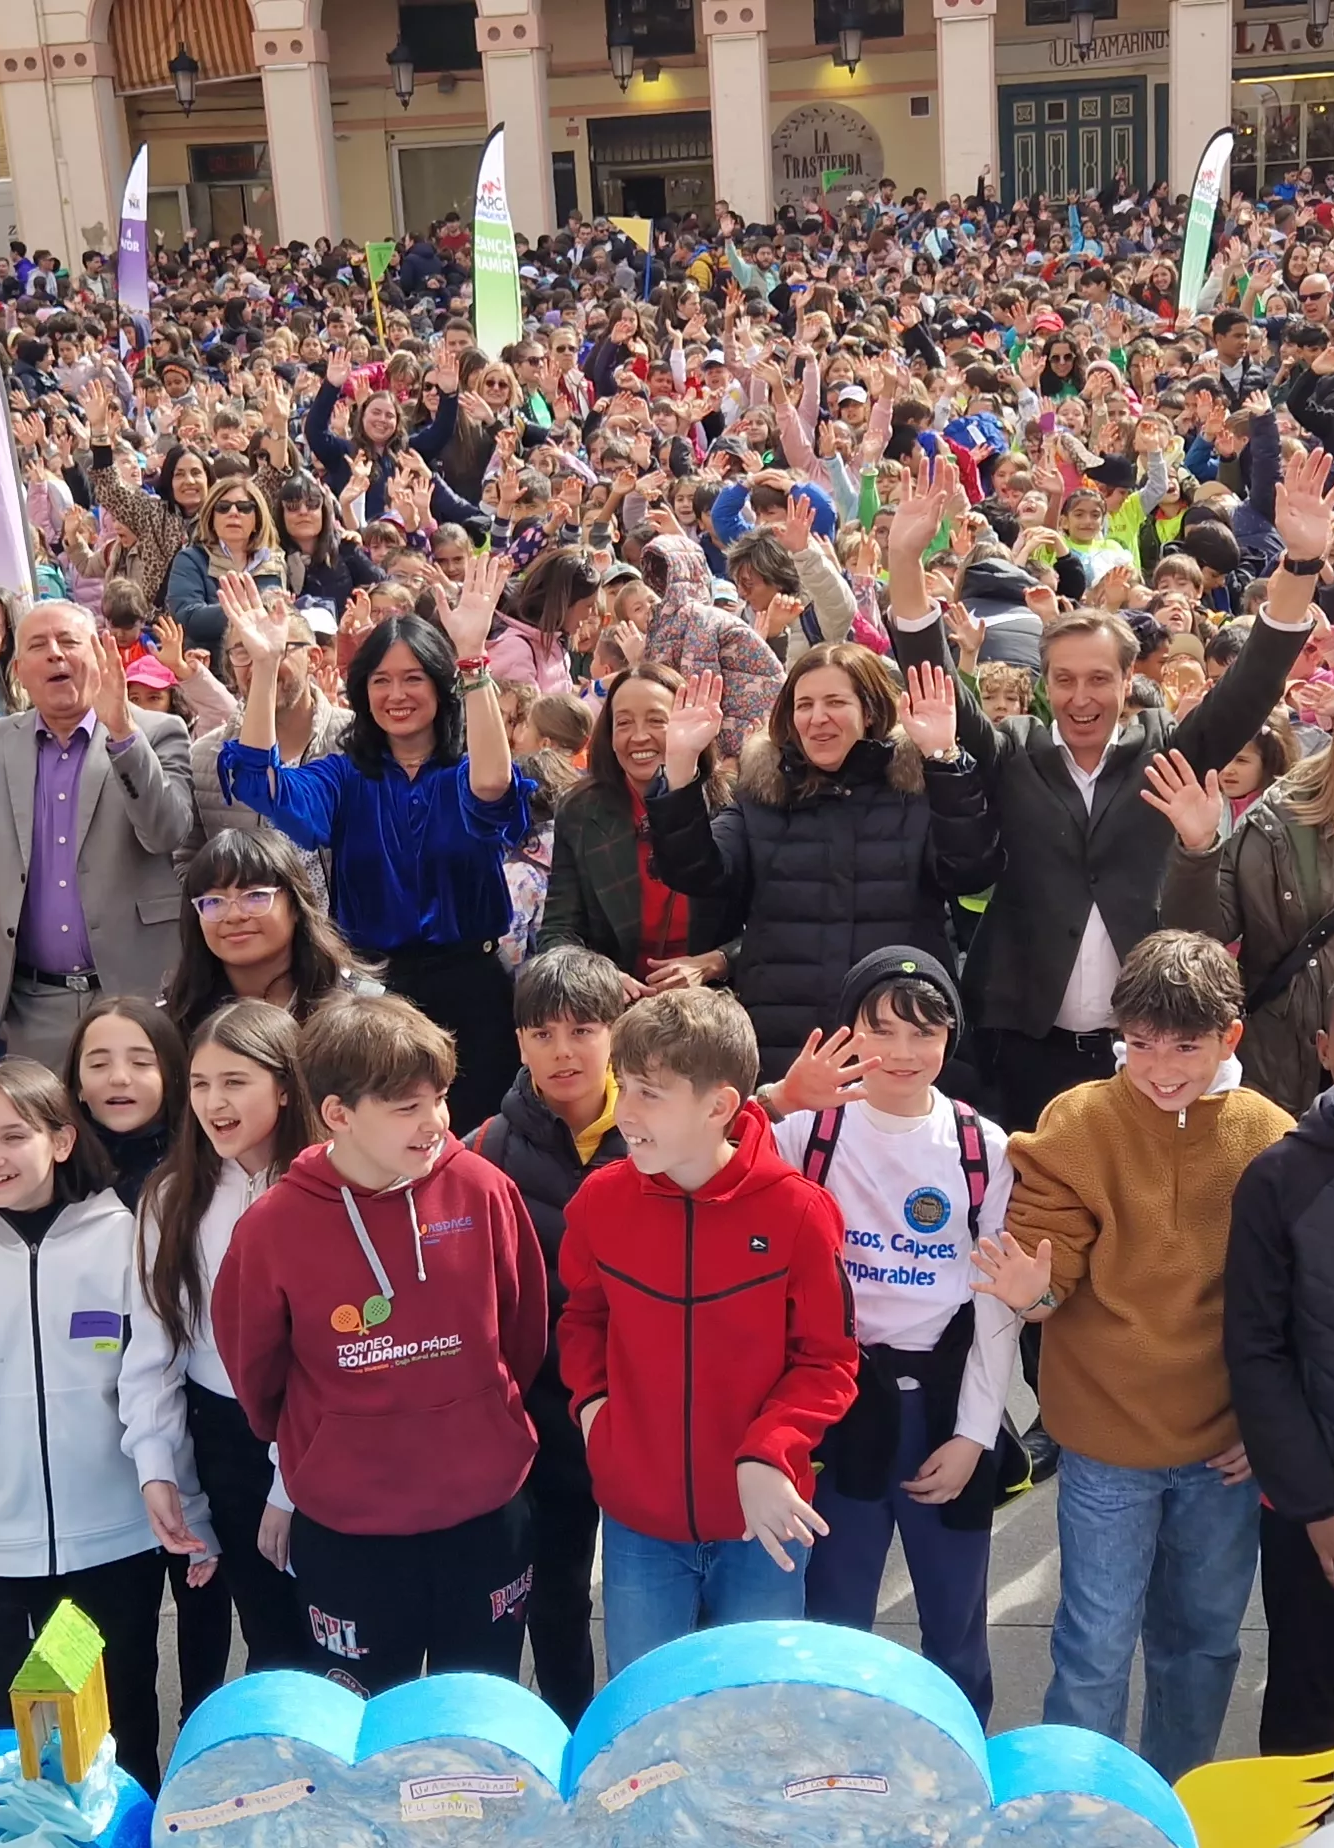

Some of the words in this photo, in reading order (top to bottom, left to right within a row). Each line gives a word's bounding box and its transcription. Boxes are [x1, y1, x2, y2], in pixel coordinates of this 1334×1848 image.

[814, 129, 831, 154] LA
[782, 154, 864, 179] TRASTIENDA
[338, 1342, 418, 1368] SOLIDARIO
[421, 1333, 463, 1352] PÁDEL
[489, 1564, 534, 1623] BULLS
[308, 1603, 361, 1660] CHI
